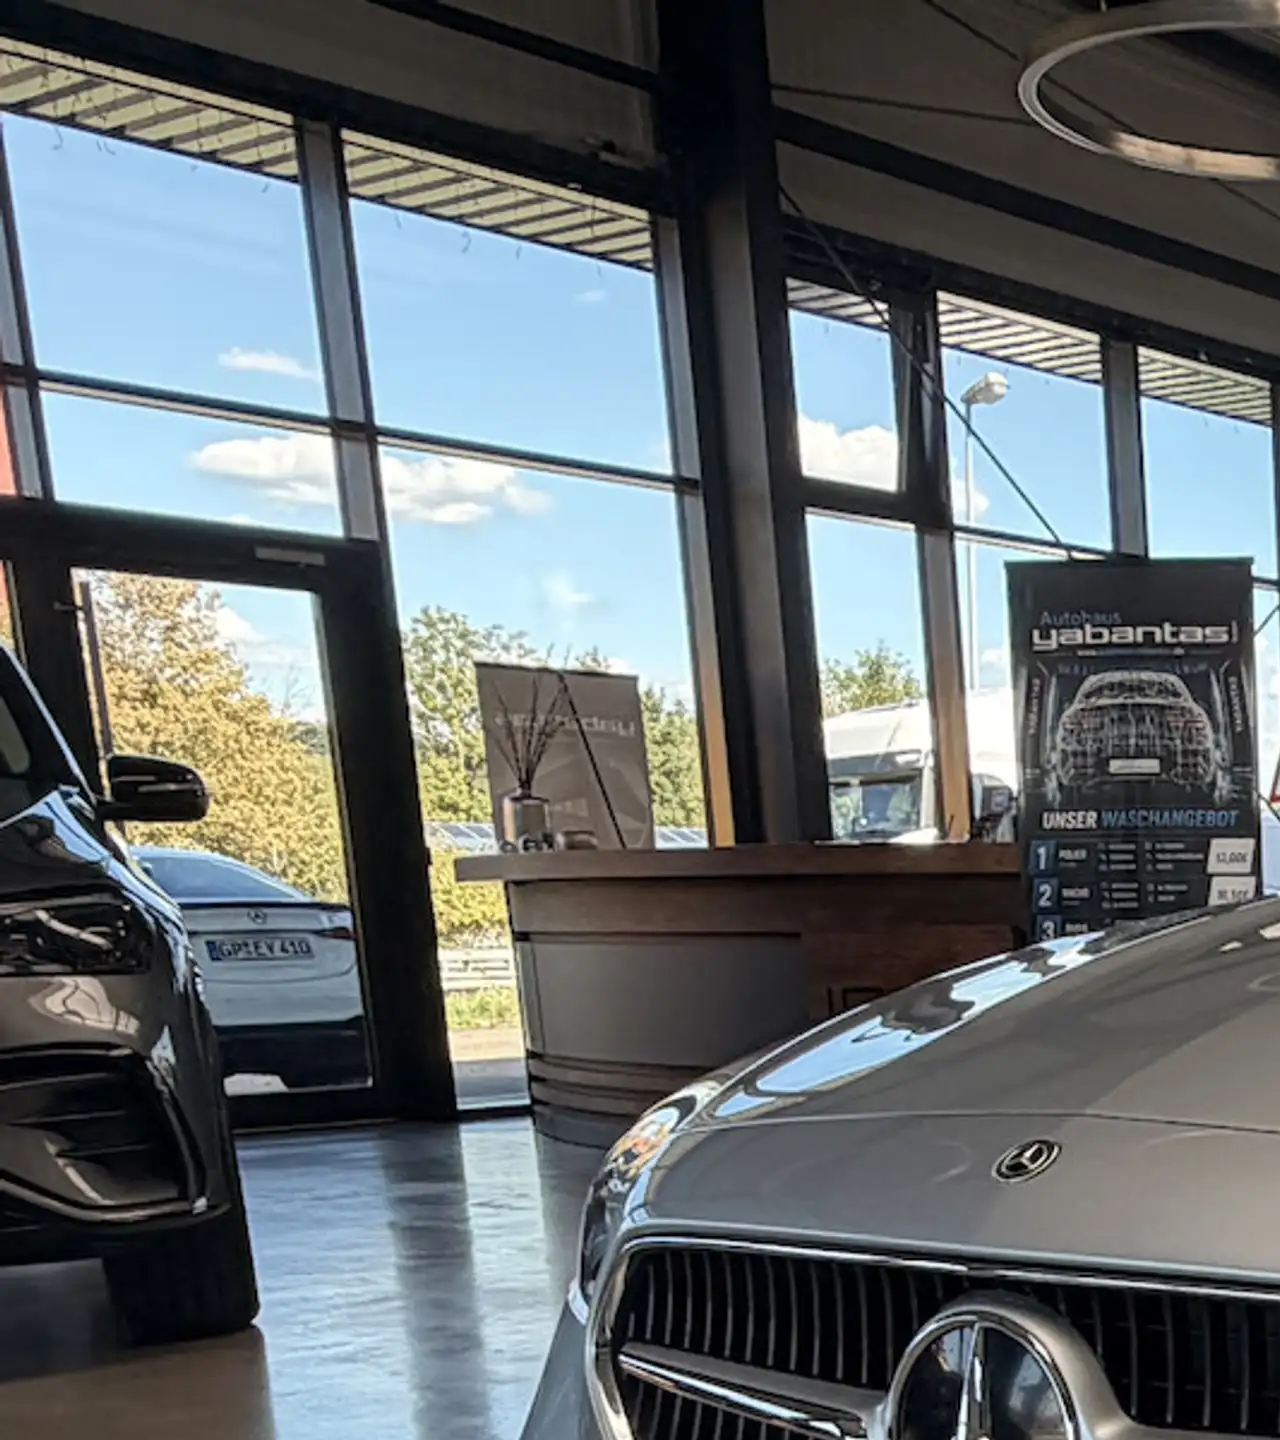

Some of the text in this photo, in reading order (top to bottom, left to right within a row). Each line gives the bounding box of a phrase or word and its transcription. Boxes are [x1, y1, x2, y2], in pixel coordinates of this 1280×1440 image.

[1040, 610, 1122, 627] Autohaus
[1032, 622, 1229, 651] yabantas
[1042, 810, 1239, 829] UNSER WASCHANGEBOT
[1037, 847, 1046, 870] 1
[1039, 886, 1051, 907] 2
[1042, 921, 1055, 941] 3
